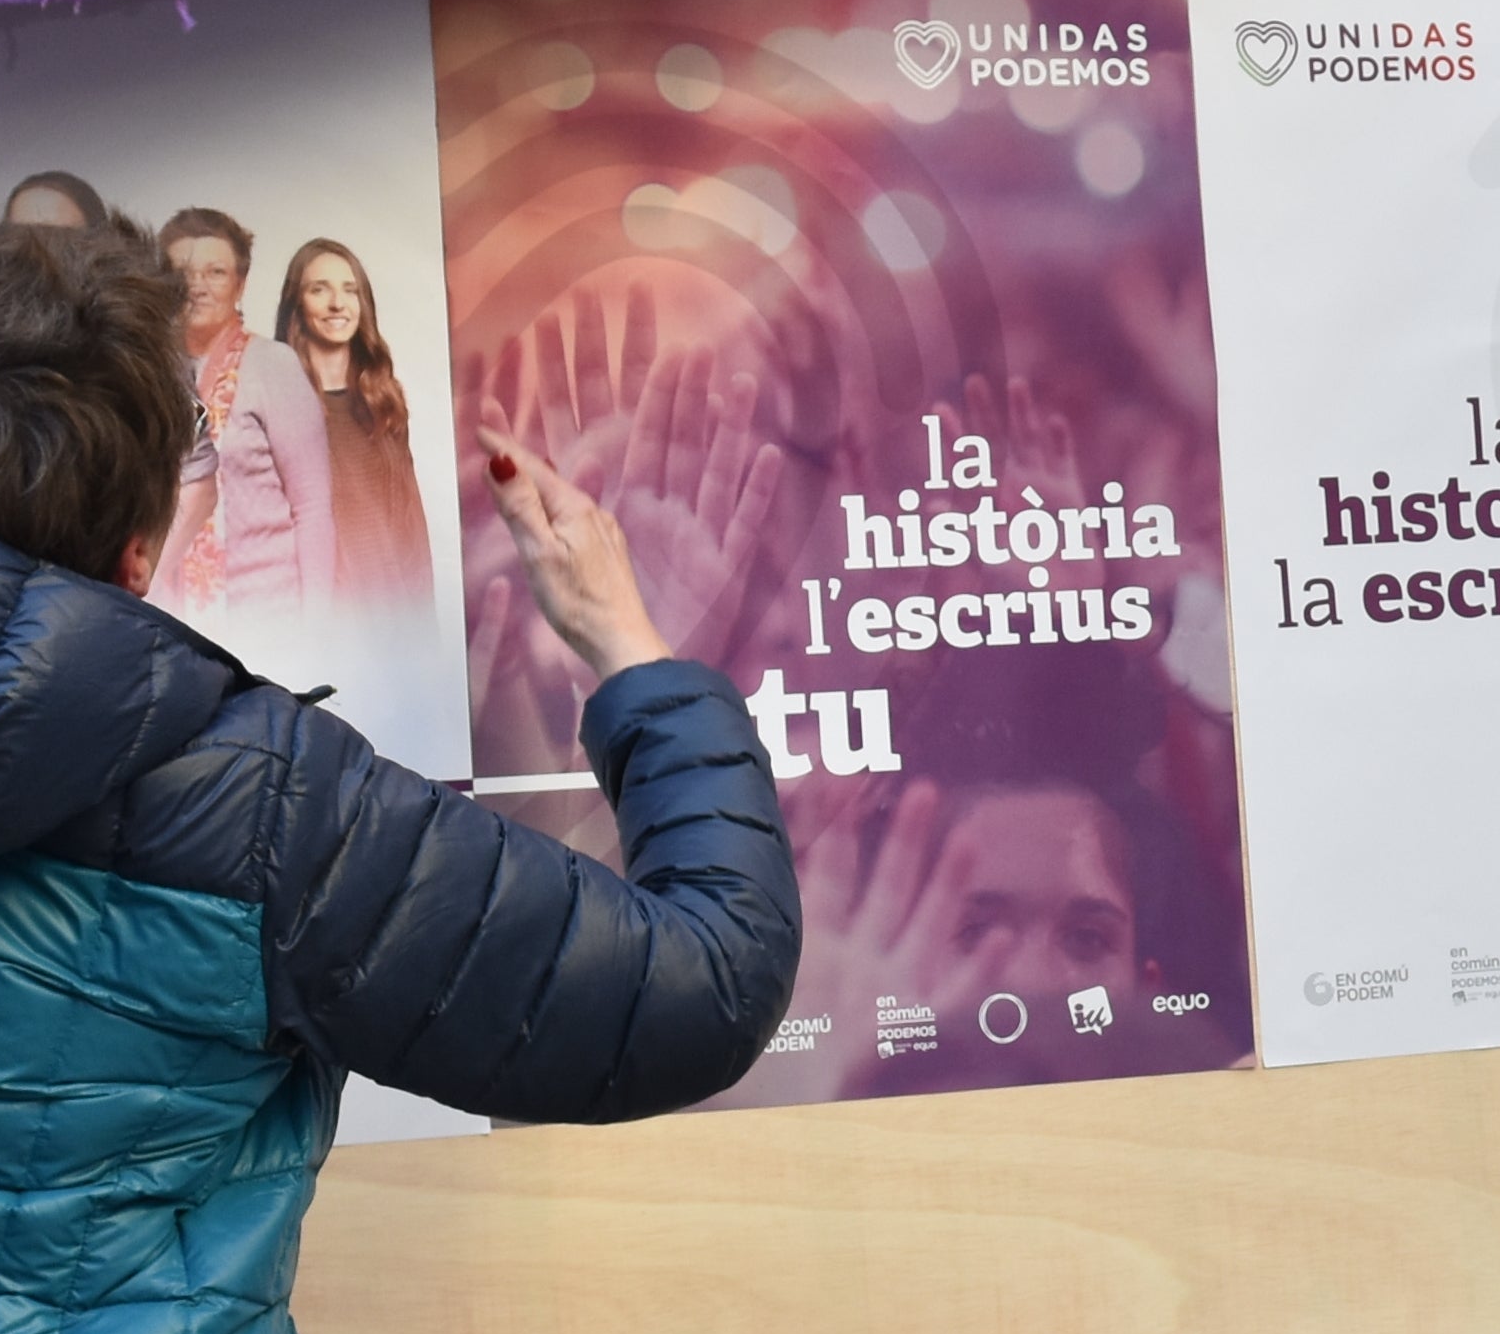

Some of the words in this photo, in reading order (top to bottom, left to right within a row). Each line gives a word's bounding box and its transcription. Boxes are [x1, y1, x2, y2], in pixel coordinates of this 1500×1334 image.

[968, 22, 1149, 54] UNIDAS
[1306, 21, 1475, 50] UNIDAS
[970, 55, 1152, 88] PODEMOS
[1308, 55, 1477, 84] PODEMOS
[920, 413, 998, 491] la
[840, 481, 1182, 570] història
[1273, 558, 1343, 629] la
[746, 668, 902, 781] tu
[1450, 947, 1468, 958] en
[1335, 972, 1357, 988] EN
[1360, 964, 1410, 986] COMÚ
[876, 995, 897, 1008] en
[1336, 985, 1394, 1003] PODEM
[778, 1013, 832, 1037] COMÚ
[877, 1025, 937, 1040] PODEMOS
[763, 1034, 815, 1054] ODEM
